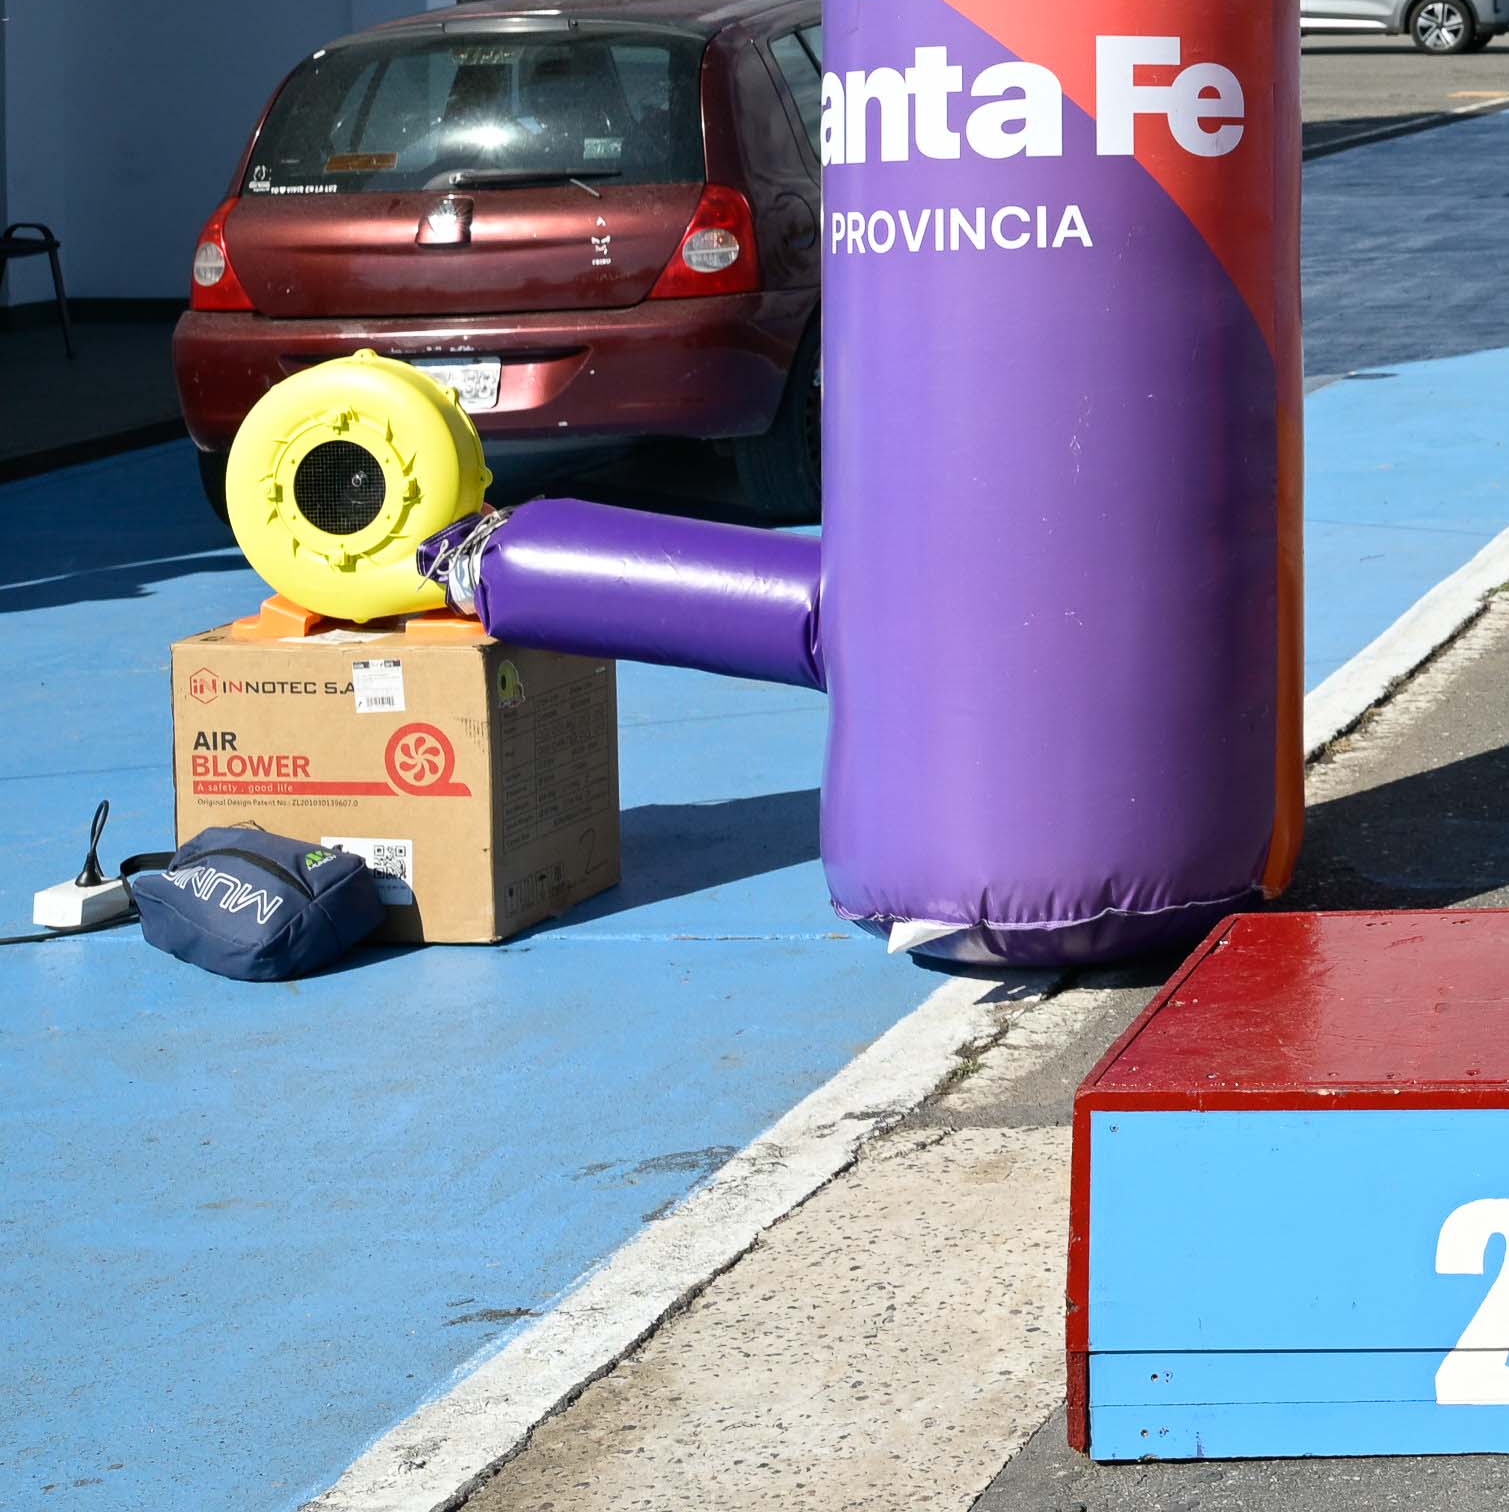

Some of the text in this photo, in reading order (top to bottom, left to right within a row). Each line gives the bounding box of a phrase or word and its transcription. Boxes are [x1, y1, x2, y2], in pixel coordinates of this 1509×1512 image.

[1095, 34, 1245, 158] Fe
[831, 203, 1094, 255] PROVINCIA
[223, 681, 318, 695] INNOTEC
[193, 731, 238, 752] AIR
[192, 754, 311, 778] BLOWER
[208, 783, 238, 794] safety
[248, 783, 273, 794] good
